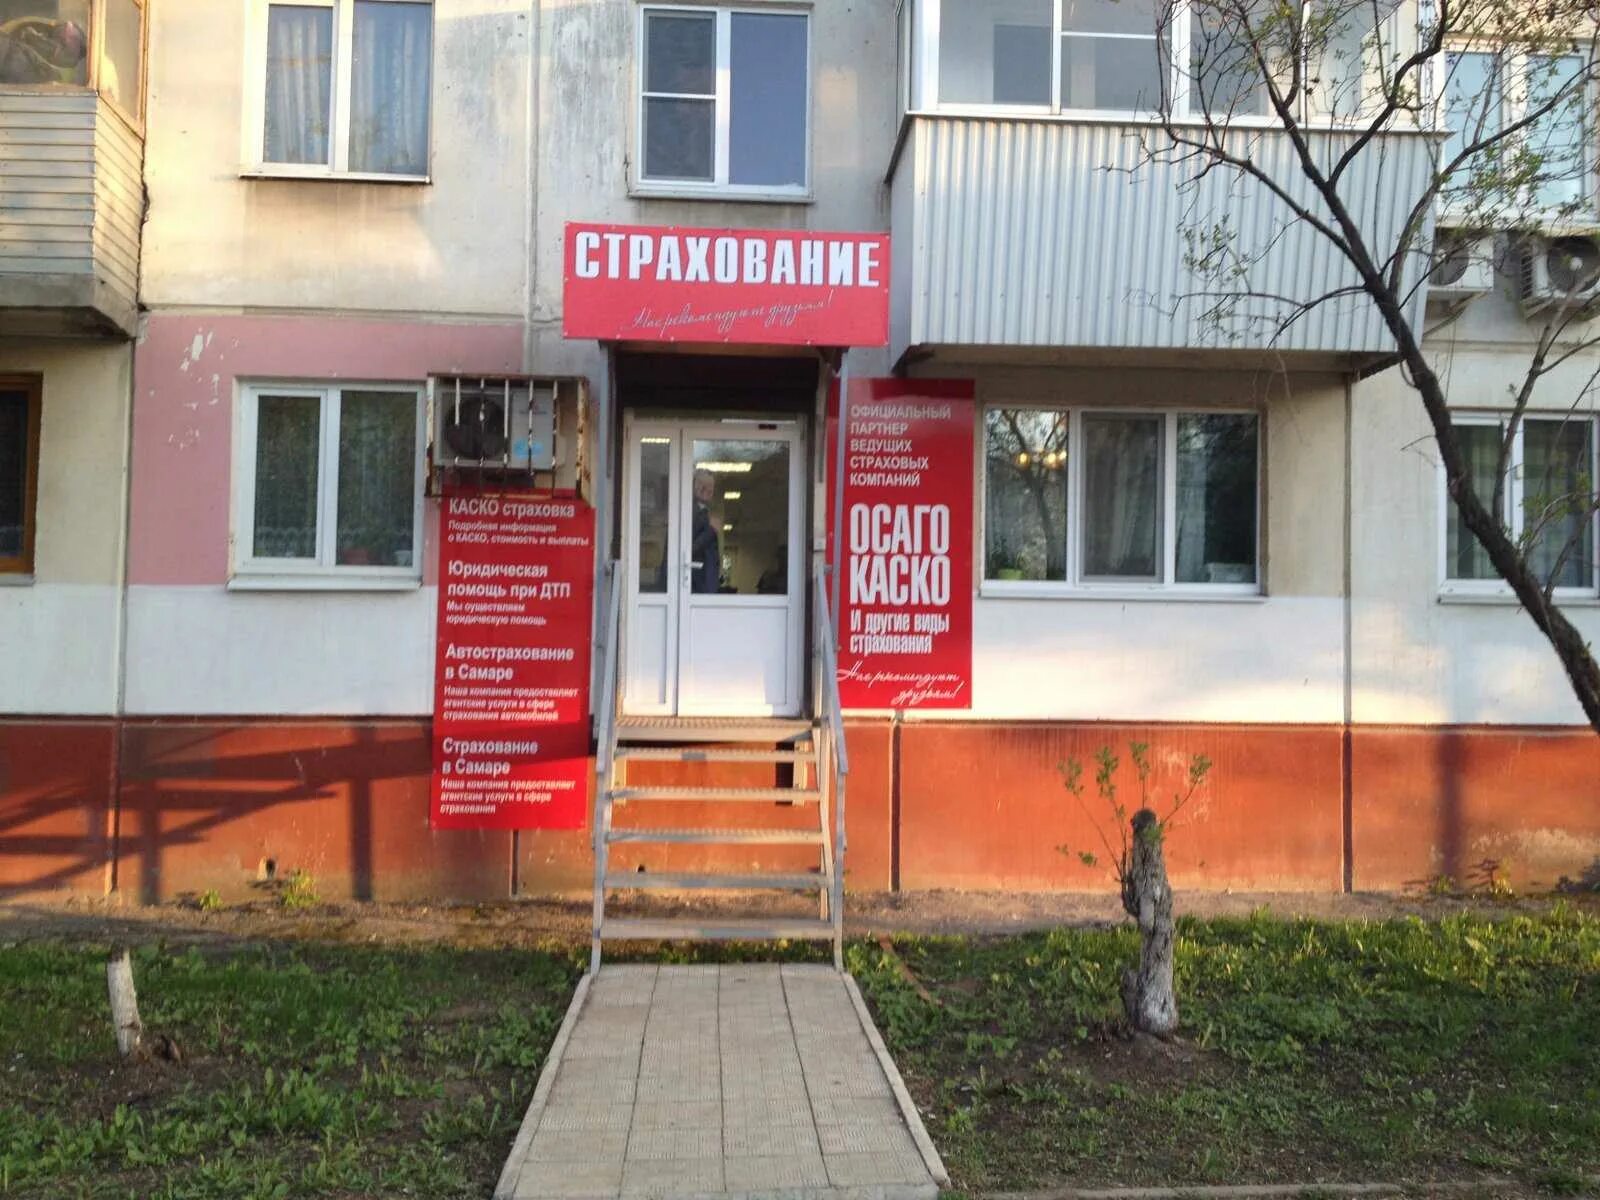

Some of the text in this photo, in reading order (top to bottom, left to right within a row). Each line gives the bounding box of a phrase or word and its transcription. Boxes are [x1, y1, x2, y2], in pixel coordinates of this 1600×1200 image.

[574, 231, 880, 288] СТРАХОВАНИЕ
[851, 404, 951, 420] ОФИЦИАЛЬНЫЙ
[850, 422, 908, 435] ПАРТНЕР
[850, 439, 912, 453] ВЕДУЩИХ
[850, 456, 929, 470] СТРАХОВЫХ
[850, 471, 920, 487] КОМПАНИЙ
[449, 498, 575, 519] КАСКО страховка
[448, 520, 557, 533] Подробная информация
[850, 503, 950, 554] ОСАГО
[456, 533, 489, 544] КАСКО,
[491, 536, 538, 545] стоимость
[548, 537, 589, 547] выплаты
[448, 560, 548, 578] Юридическая
[850, 554, 950, 606] КАСКО
[448, 582, 571, 600] помощь при ДТП
[447, 601, 462, 611] Мы
[446, 614, 547, 625] юридическую помощь
[850, 609, 949, 635] И другие виды
[445, 643, 574, 663] Автострахование
[850, 634, 932, 656] страхования
[445, 664, 514, 683] в Самаре
[444, 686, 467, 696] Наша
[513, 687, 579, 698] предоставляет
[444, 700, 486, 708] агентские
[488, 701, 517, 711] услуги
[527, 699, 555, 711] сфере
[443, 710, 559, 721] страхования автомобилей
[442, 737, 538, 755] Страхование
[442, 758, 511, 778] в Самаре
[441, 778, 575, 791] Наша компания предоставляет
[440, 792, 483, 801] агентские
[485, 792, 514, 803] услуги
[523, 791, 552, 803] сфере
[440, 804, 496, 815] страхования
